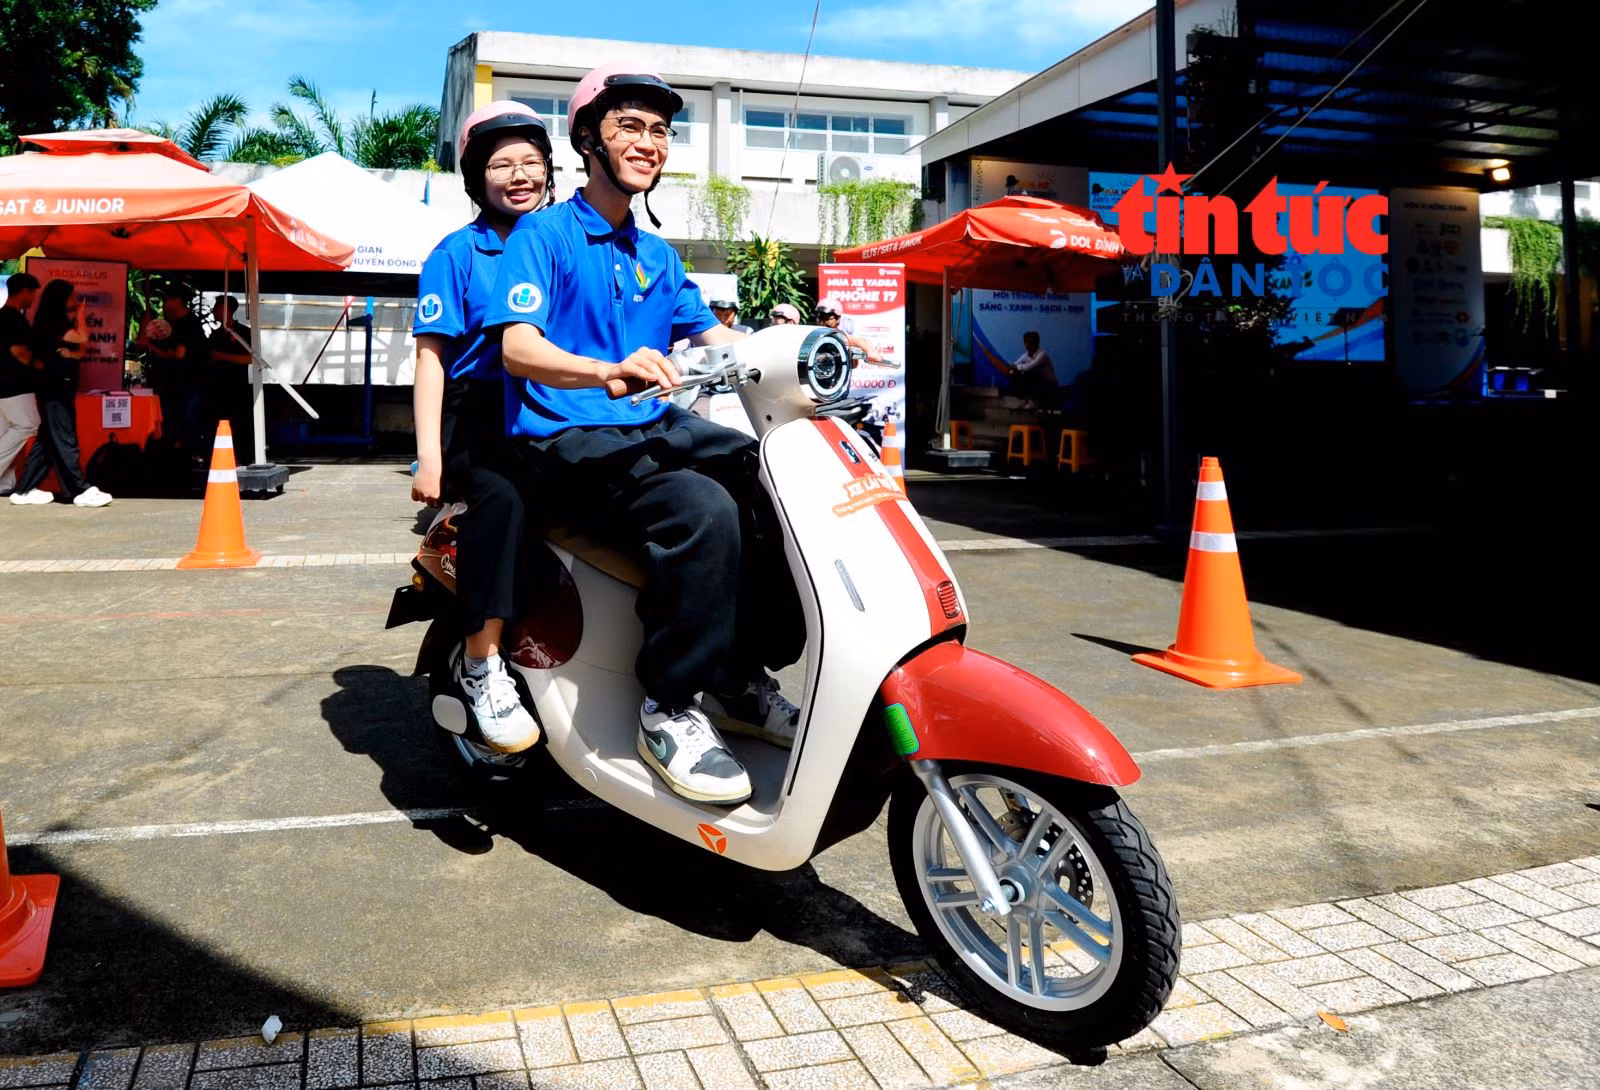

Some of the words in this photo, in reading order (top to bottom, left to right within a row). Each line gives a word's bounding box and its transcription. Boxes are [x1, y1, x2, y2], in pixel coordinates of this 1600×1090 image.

[32, 198, 47, 215] &
[52, 197, 125, 214] JUNIOR
[1070, 235, 1092, 249] DOL
[1094, 236, 1120, 253] ĐÌNH
[357, 246, 383, 254] GIAN
[827, 278, 849, 287] MUA
[850, 278, 864, 287] XE
[865, 278, 898, 287] YADEA
[827, 290, 880, 302] IPHONE
[882, 290, 898, 303] 17
[1009, 303, 1033, 311] XANH
[88, 333, 117, 342] ANH
